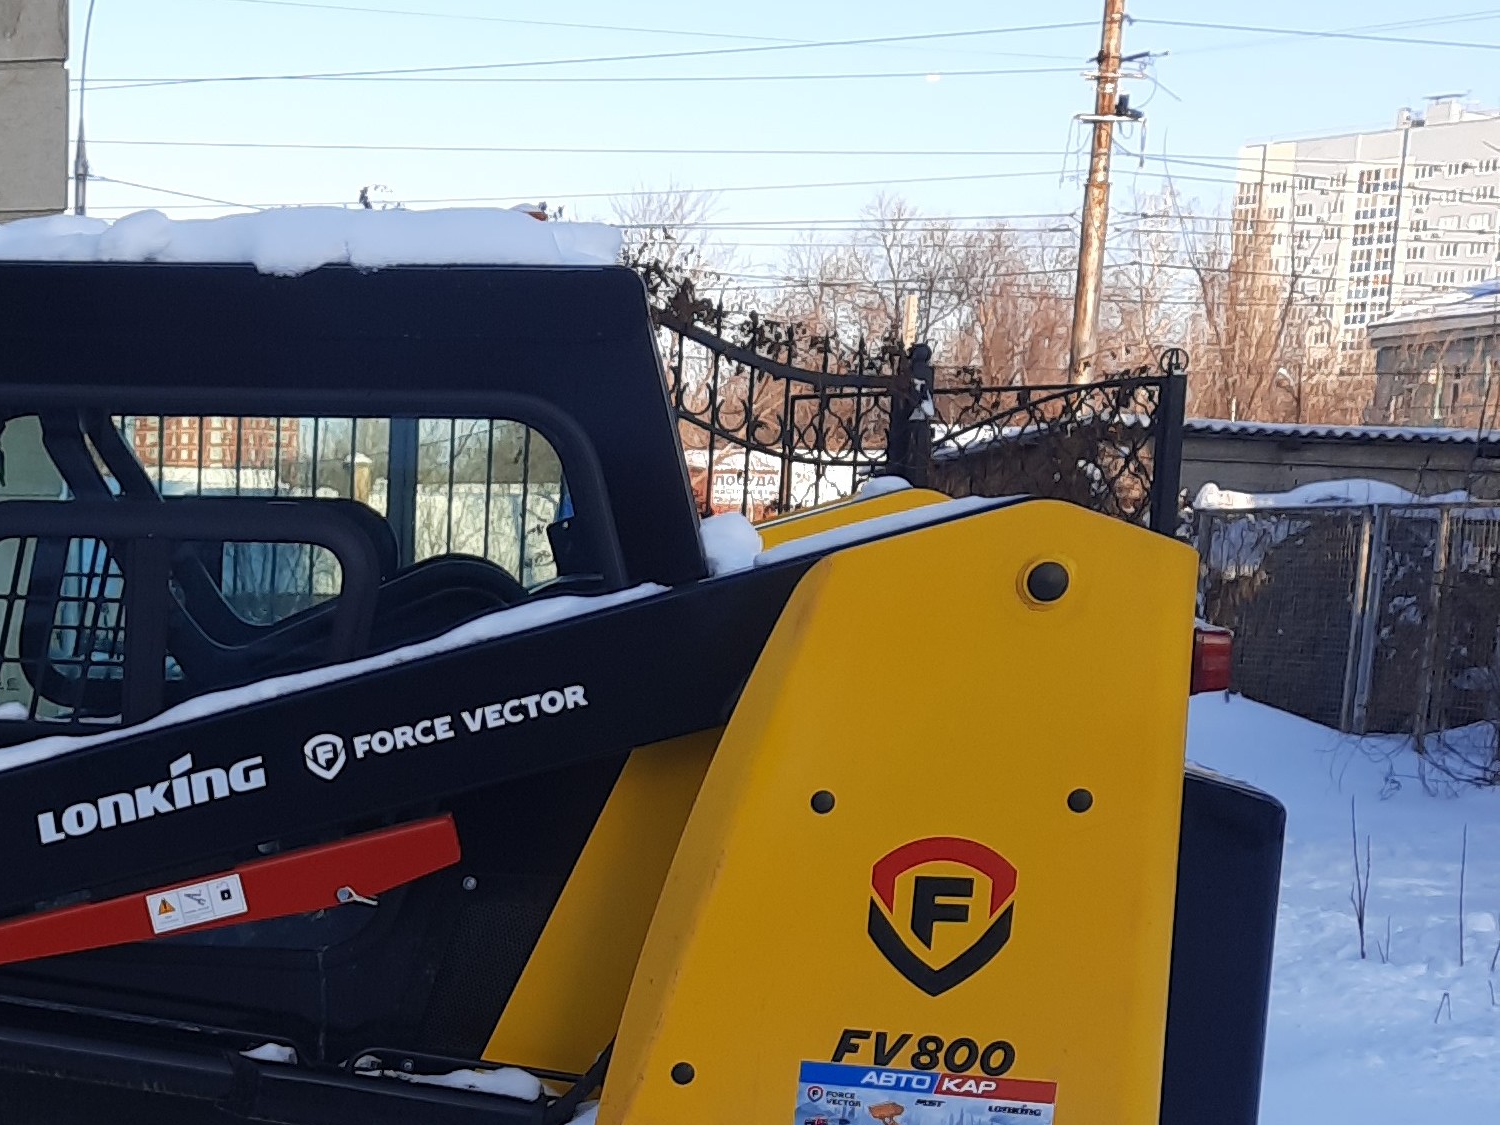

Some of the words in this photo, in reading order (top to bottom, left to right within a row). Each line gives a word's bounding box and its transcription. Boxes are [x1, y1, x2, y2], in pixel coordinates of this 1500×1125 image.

[353, 714, 456, 759] FORCE
[461, 684, 589, 733] VECTOR
[830, 1028, 1017, 1077] FV800
[825, 1090, 856, 1100] FORCE
[860, 1070, 932, 1090] АВТО
[940, 1077, 998, 1095] КАР
[825, 1098, 862, 1108] VECTOR
